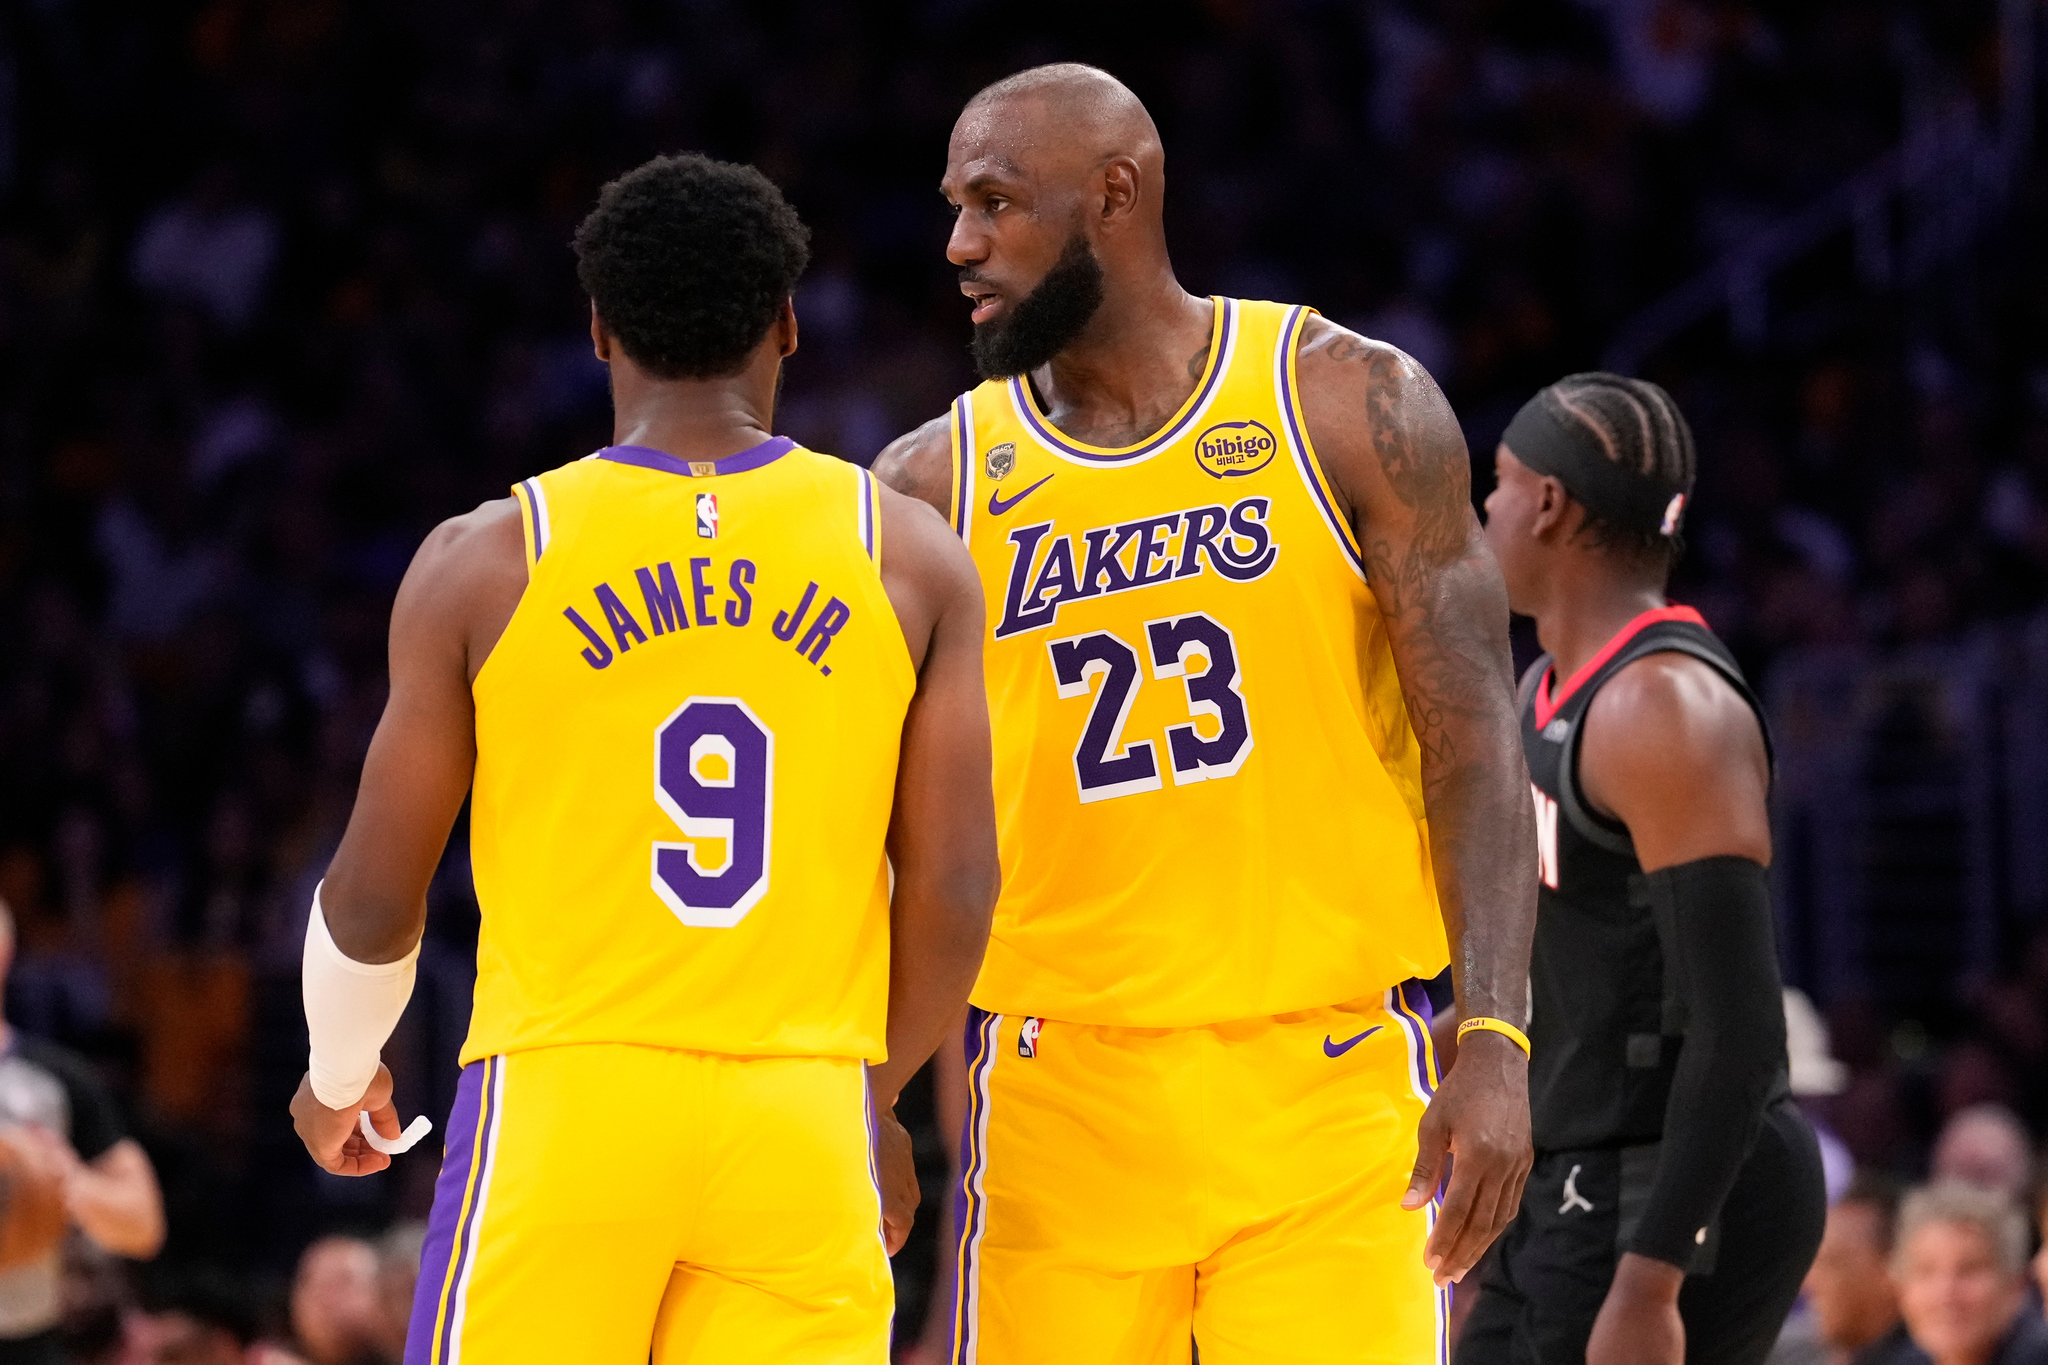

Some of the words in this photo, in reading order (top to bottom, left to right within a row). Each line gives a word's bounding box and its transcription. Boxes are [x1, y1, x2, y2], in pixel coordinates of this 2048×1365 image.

[988, 444, 1012, 456] LEGACY
[1202, 436, 1271, 458] bibigo
[1216, 454, 1245, 466] 비비고
[562, 557, 757, 670] JAMES
[772, 580, 851, 677] JR.
[995, 496, 1280, 641] LAKERS
[1046, 610, 1254, 805] 23
[651, 695, 774, 928] 9
